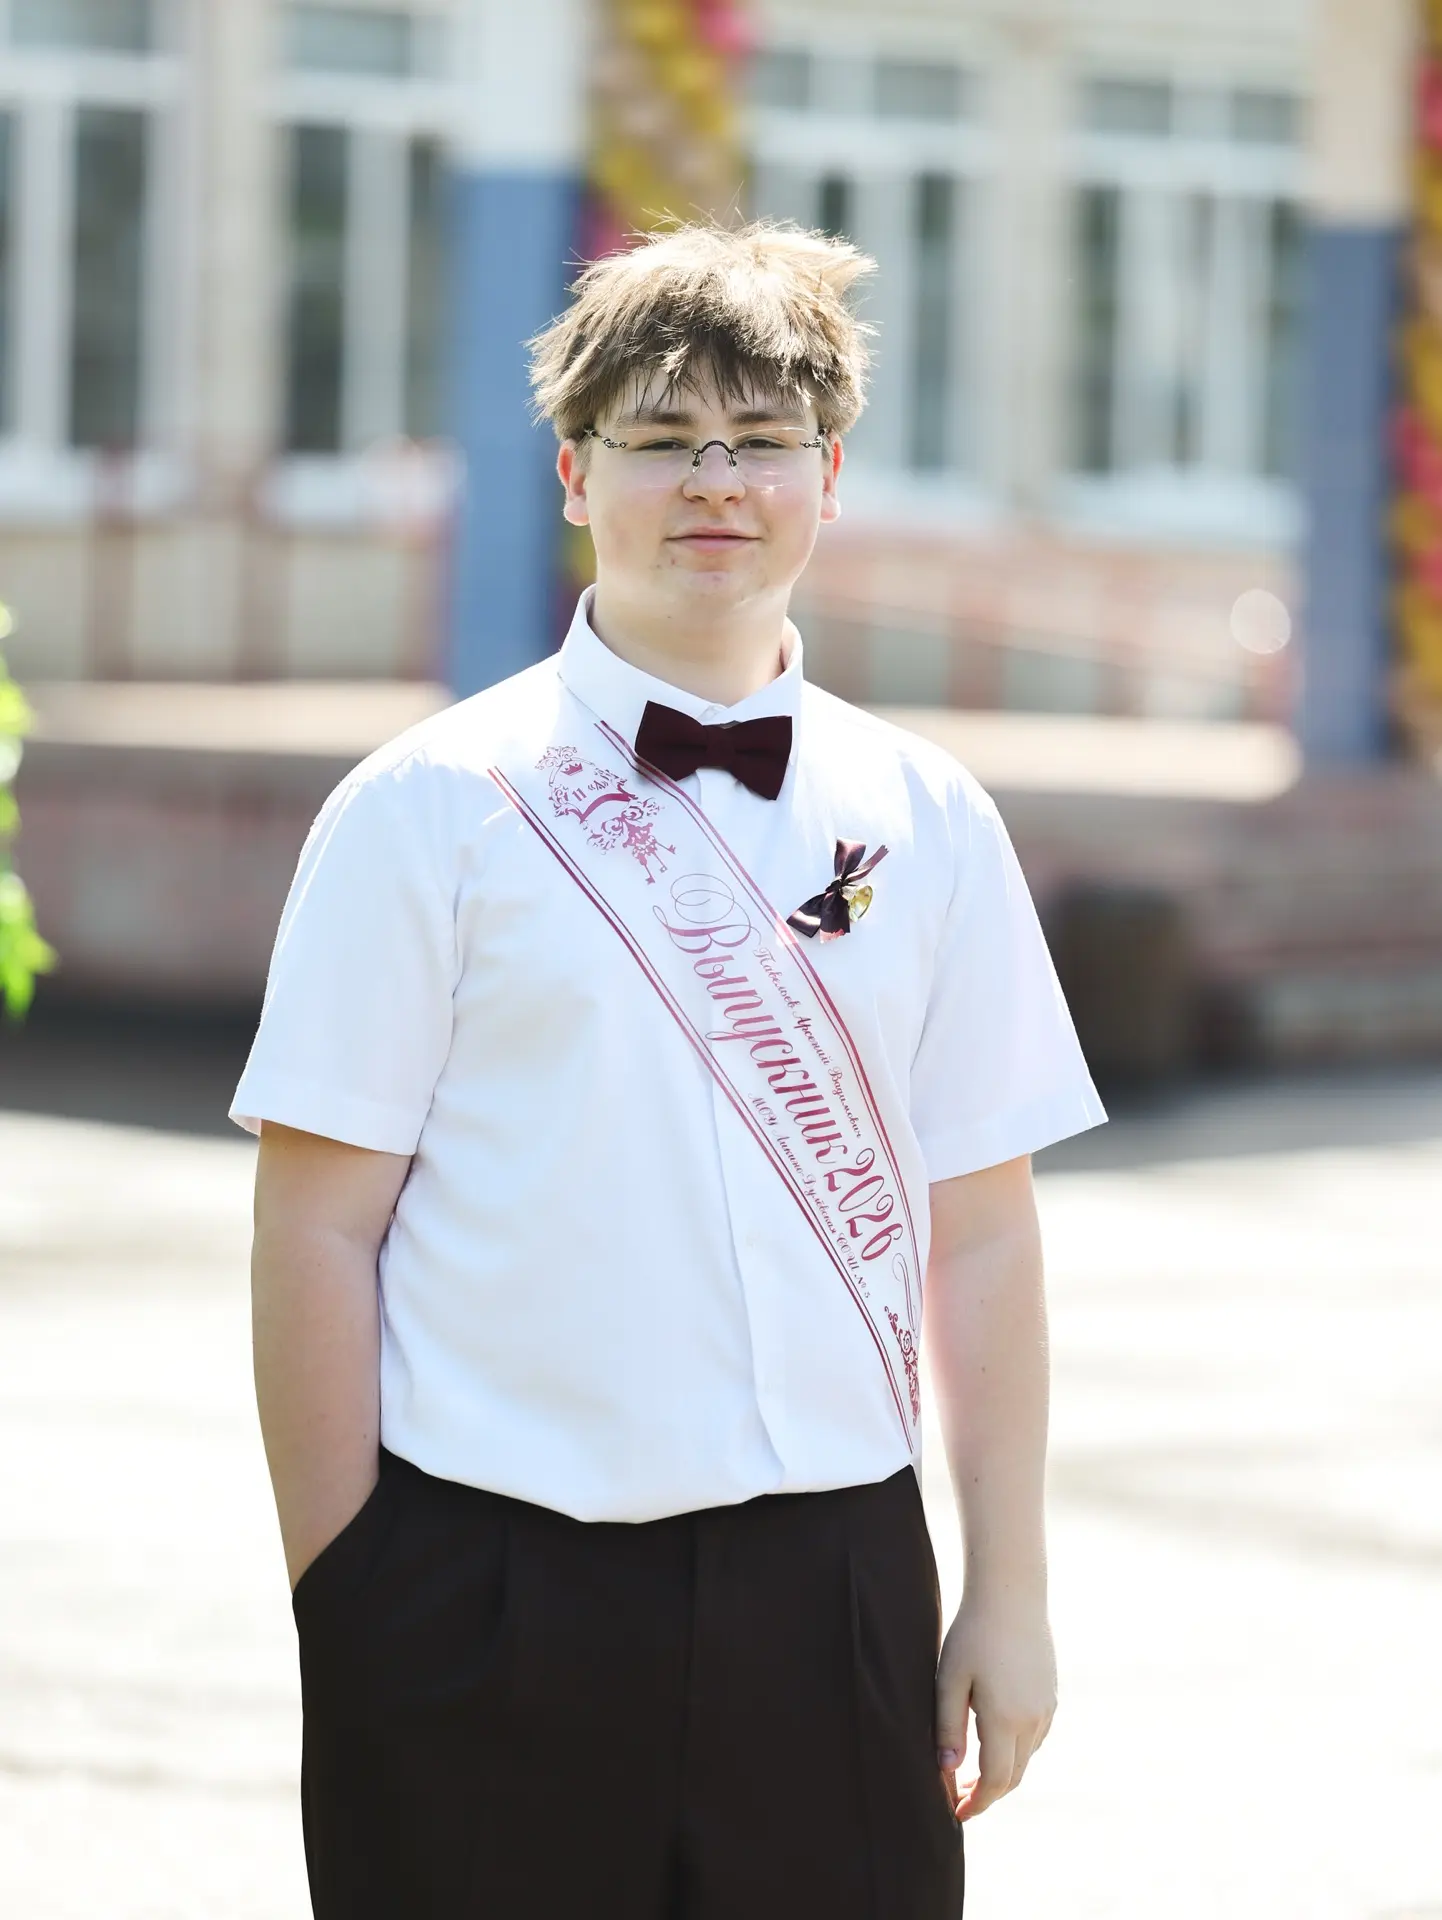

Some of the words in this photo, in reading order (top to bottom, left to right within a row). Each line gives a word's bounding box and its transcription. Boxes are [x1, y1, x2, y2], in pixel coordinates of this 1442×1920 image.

[572, 788, 587, 801] 11
[652, 873, 848, 1165] Выпускник
[824, 1148, 904, 1261] 2026
[792, 1011, 832, 1065] Арсений
[828, 1067, 862, 1139] Вадимович
[836, 1232, 861, 1272] СОШ
